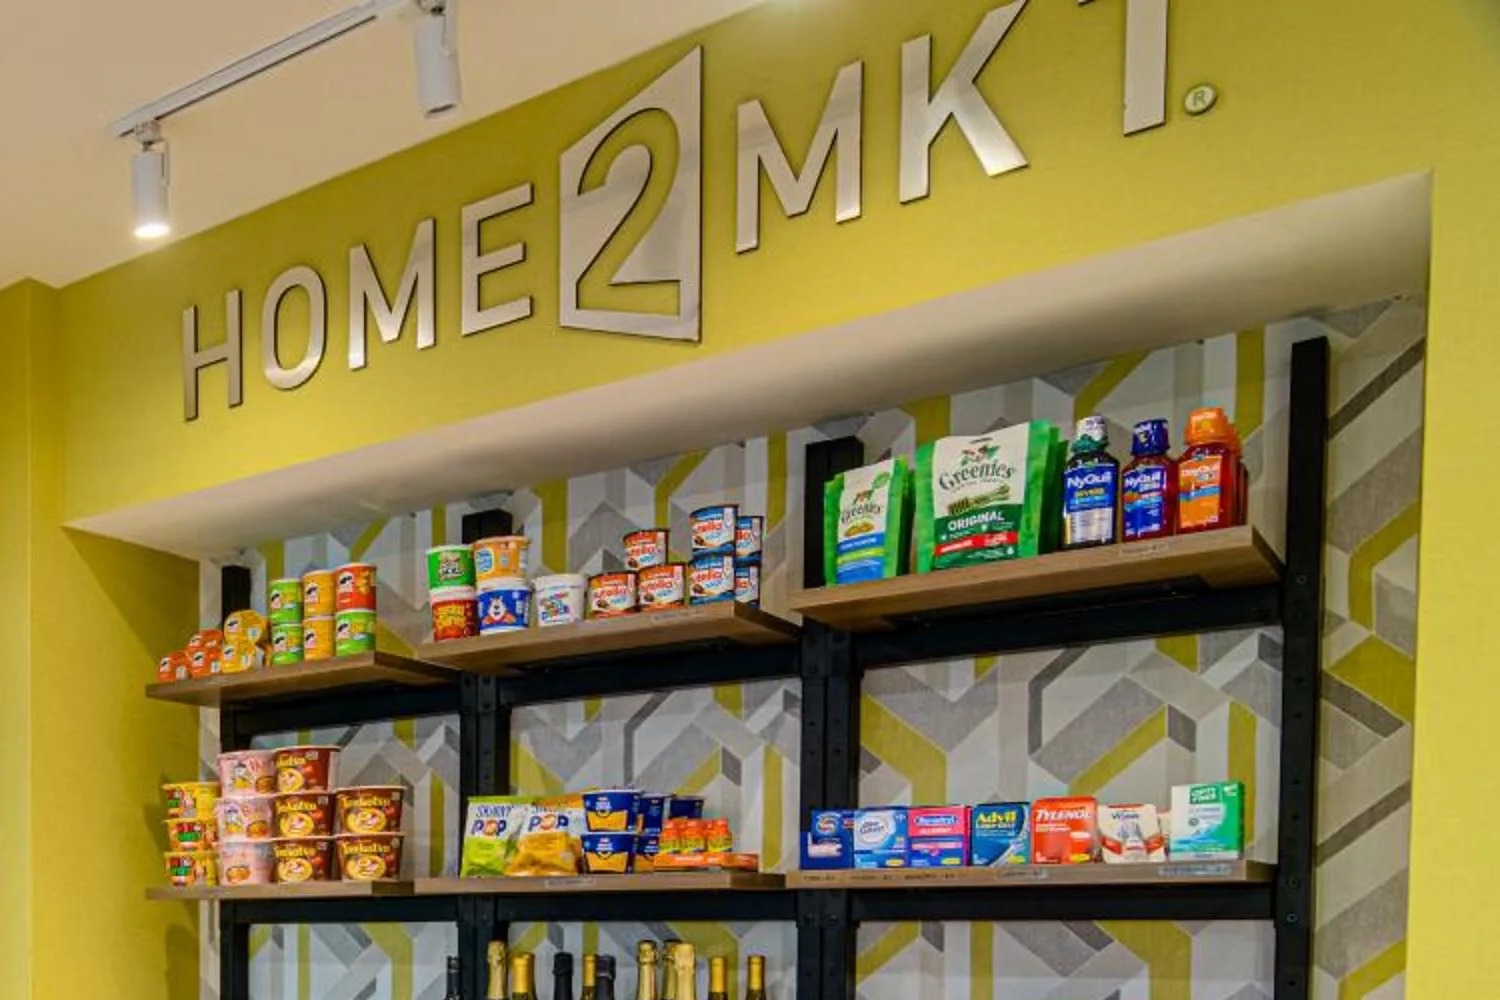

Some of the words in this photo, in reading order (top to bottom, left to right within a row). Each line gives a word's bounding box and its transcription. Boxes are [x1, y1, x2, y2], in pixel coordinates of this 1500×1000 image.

[182, 182, 535, 421] HOME
[938, 461, 1016, 492] Greenies
[946, 510, 1005, 533] ORIGINAL
